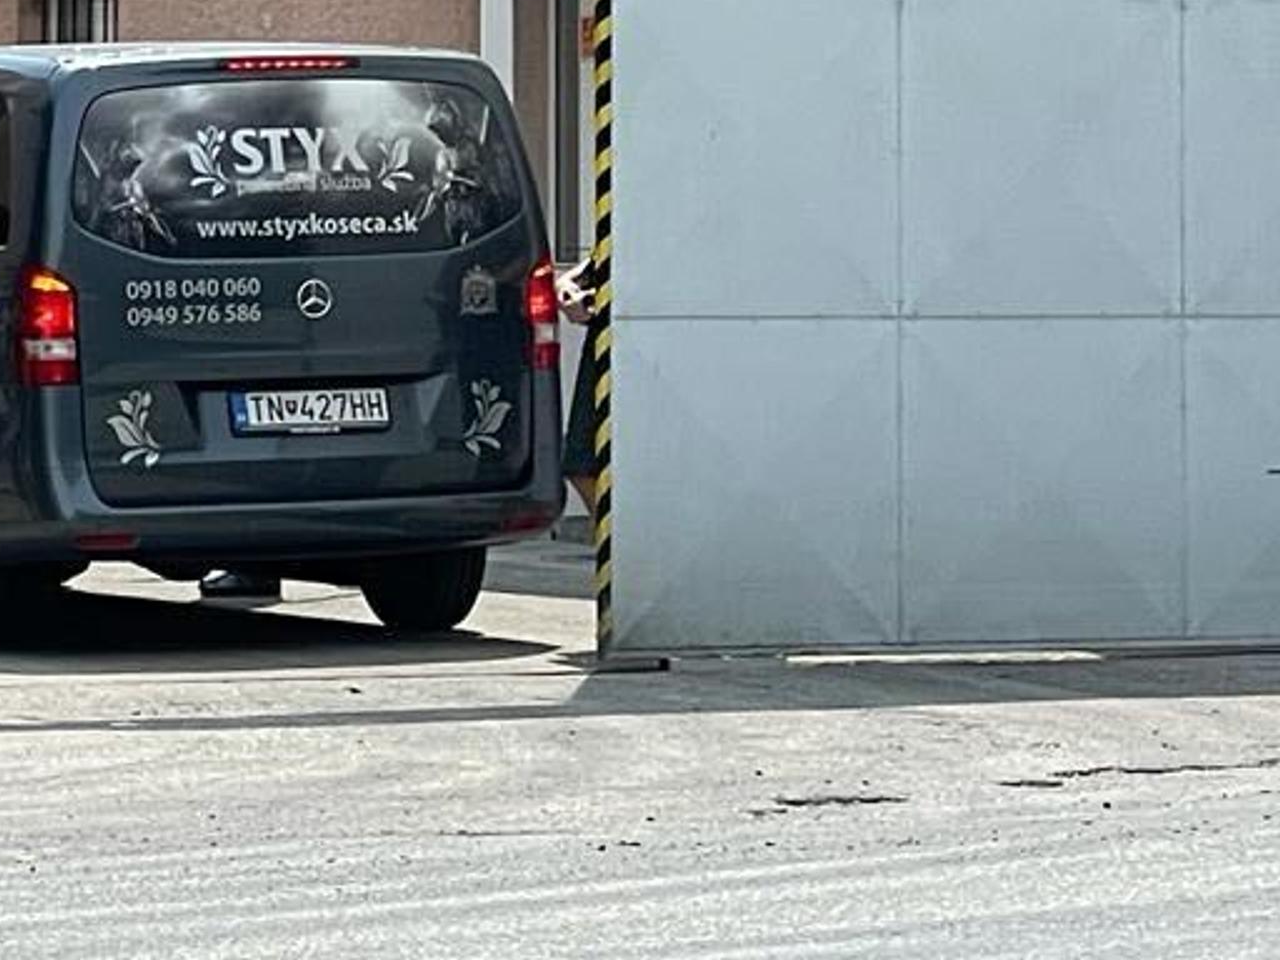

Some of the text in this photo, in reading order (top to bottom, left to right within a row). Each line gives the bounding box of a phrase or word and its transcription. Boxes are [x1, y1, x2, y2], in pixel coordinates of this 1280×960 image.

[231, 127, 370, 175] STYX
[196, 211, 420, 241] www.styxkoseca.sk
[125, 276, 262, 301] 0918 040 060
[127, 302, 262, 327] 0949 576 586
